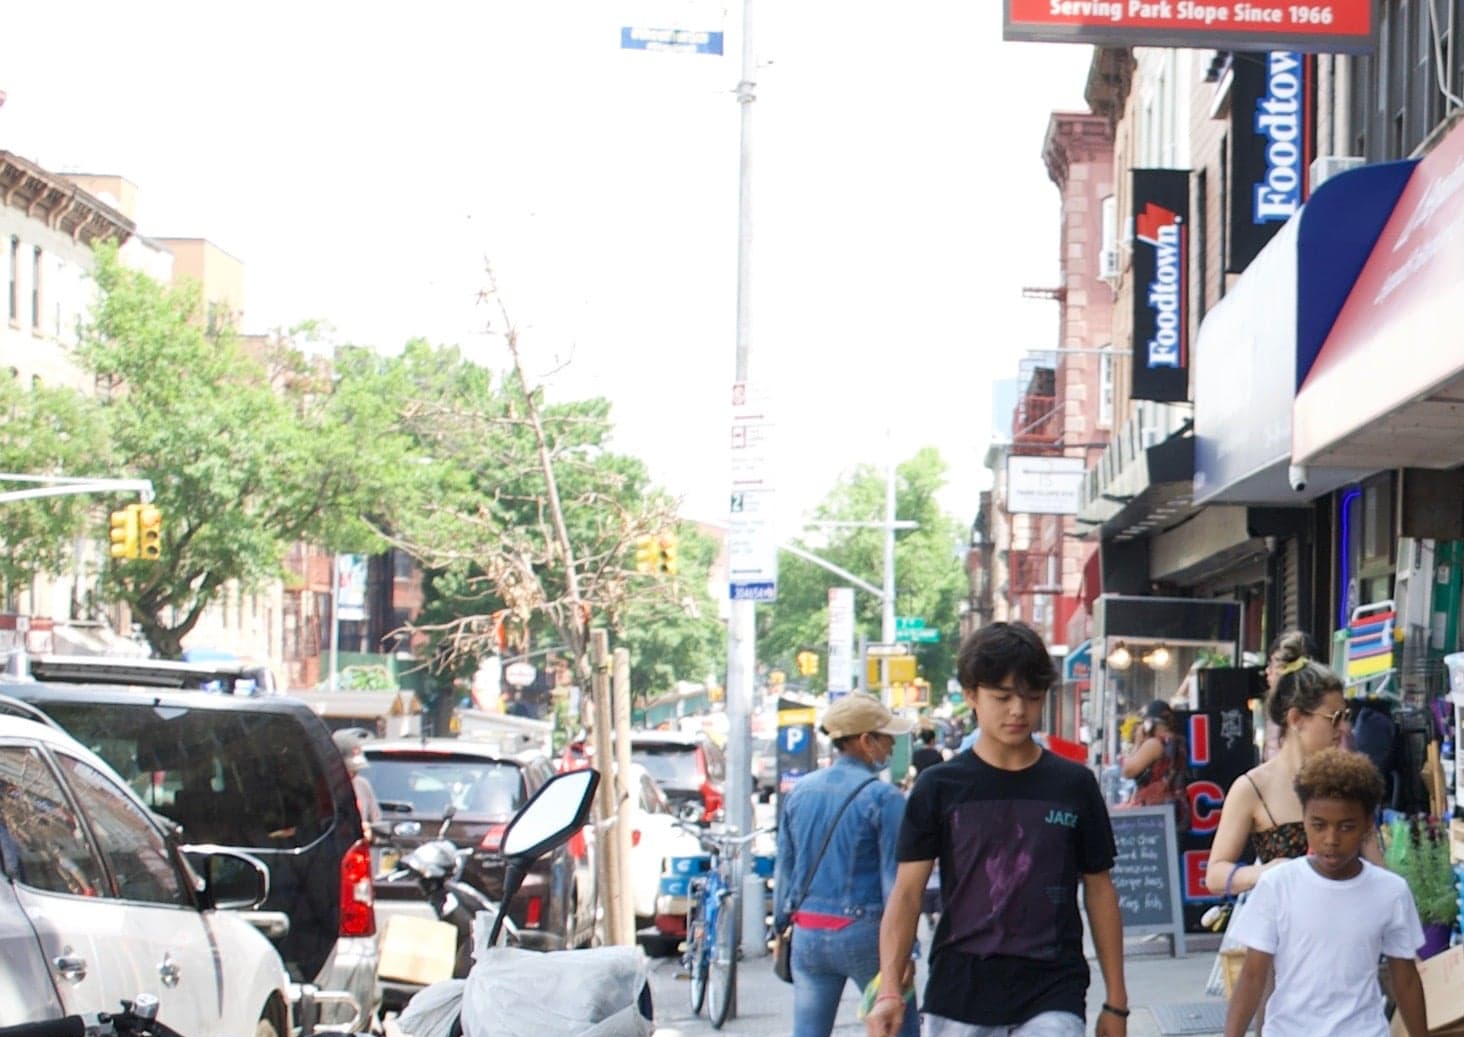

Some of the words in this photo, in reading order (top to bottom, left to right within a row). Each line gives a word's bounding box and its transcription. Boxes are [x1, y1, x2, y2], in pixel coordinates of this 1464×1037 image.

[1050, 0, 1122, 21] Serving
[1128, 0, 1171, 19] Park
[1176, 1, 1228, 24] Slope
[1234, 3, 1282, 23] Since
[1288, 6, 1333, 24] 1966
[1257, 52, 1299, 219] Foodtow
